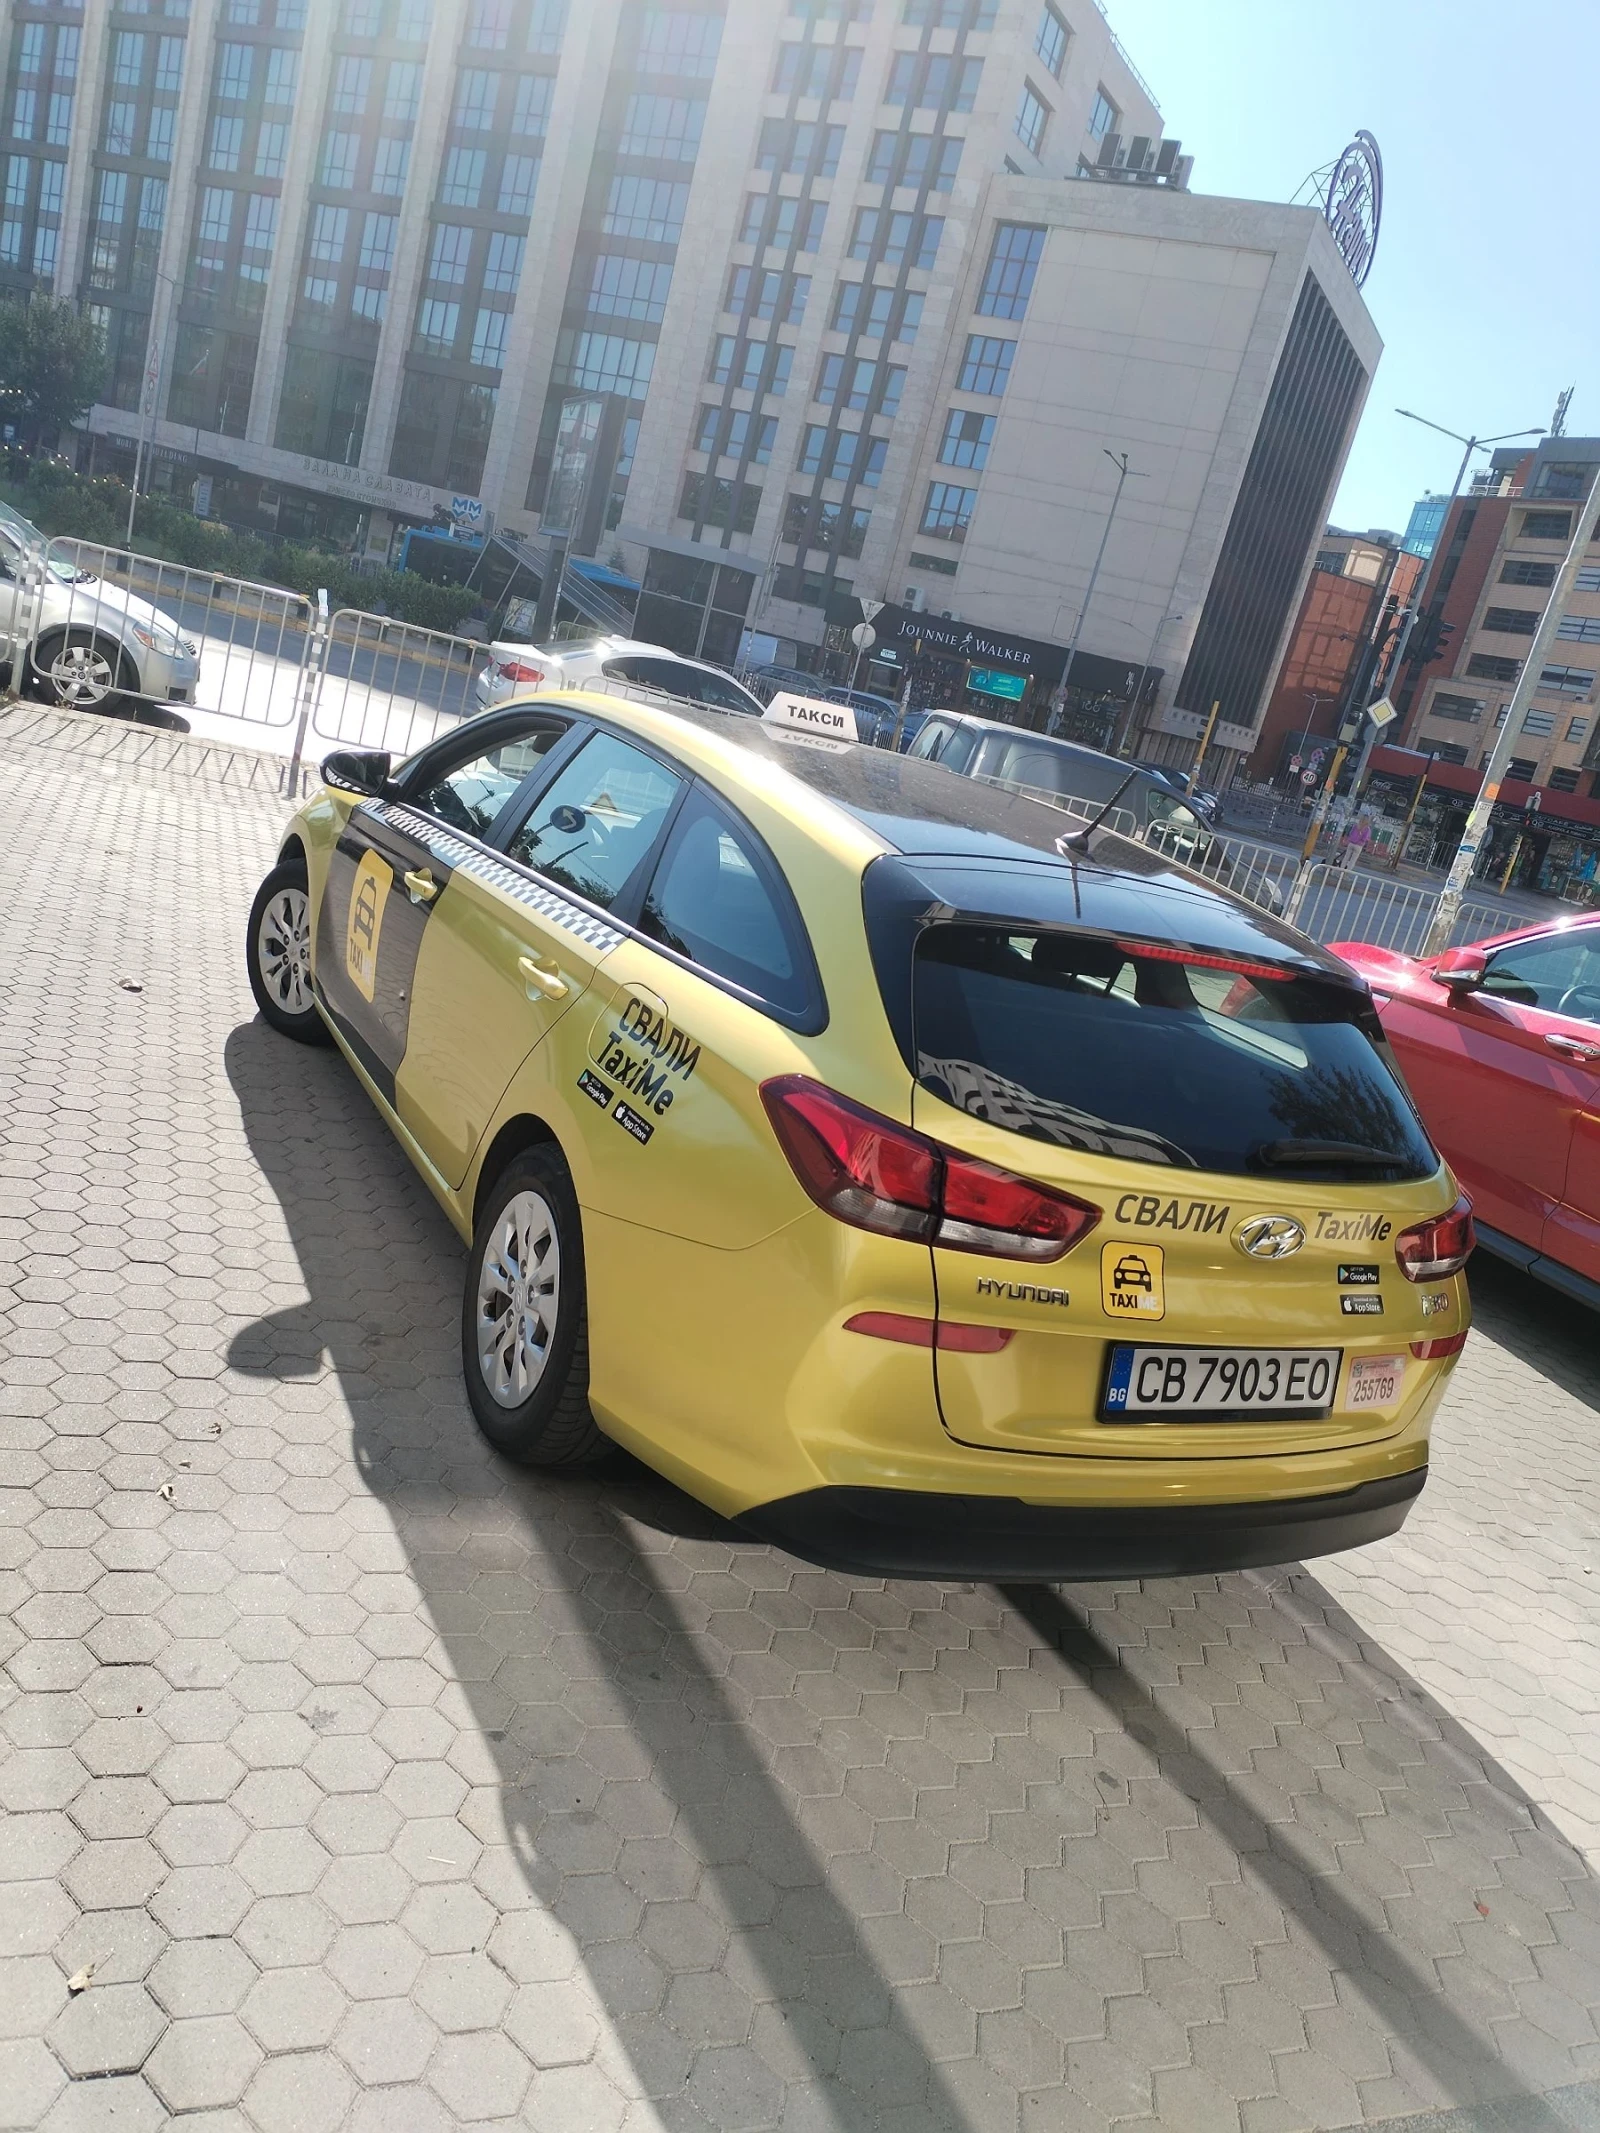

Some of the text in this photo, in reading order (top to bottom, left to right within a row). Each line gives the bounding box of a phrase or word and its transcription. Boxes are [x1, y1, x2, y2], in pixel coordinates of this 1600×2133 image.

[303, 459, 432, 501] ЗАЛА НА СЛАВАТА
[898, 621, 1031, 664] JOHNNIE WALKER
[788, 705, 844, 728] ТАКСИ
[1303, 773, 1315, 783] 40
[619, 998, 701, 1081] СВАЛИ
[597, 1031, 674, 1115] TaxiMe
[586, 1083, 607, 1106] Google Play
[622, 1116, 647, 1141] App Store
[1114, 1194, 1230, 1234] СВАЛИ
[1314, 1211, 1392, 1242] TaxiMe
[1350, 1272, 1377, 1282] Google Play
[976, 1277, 1070, 1307] HYUNDAI
[1354, 1303, 1380, 1313] App Store
[1108, 1387, 1127, 1402] BG
[1353, 1377, 1394, 1402] 255769
